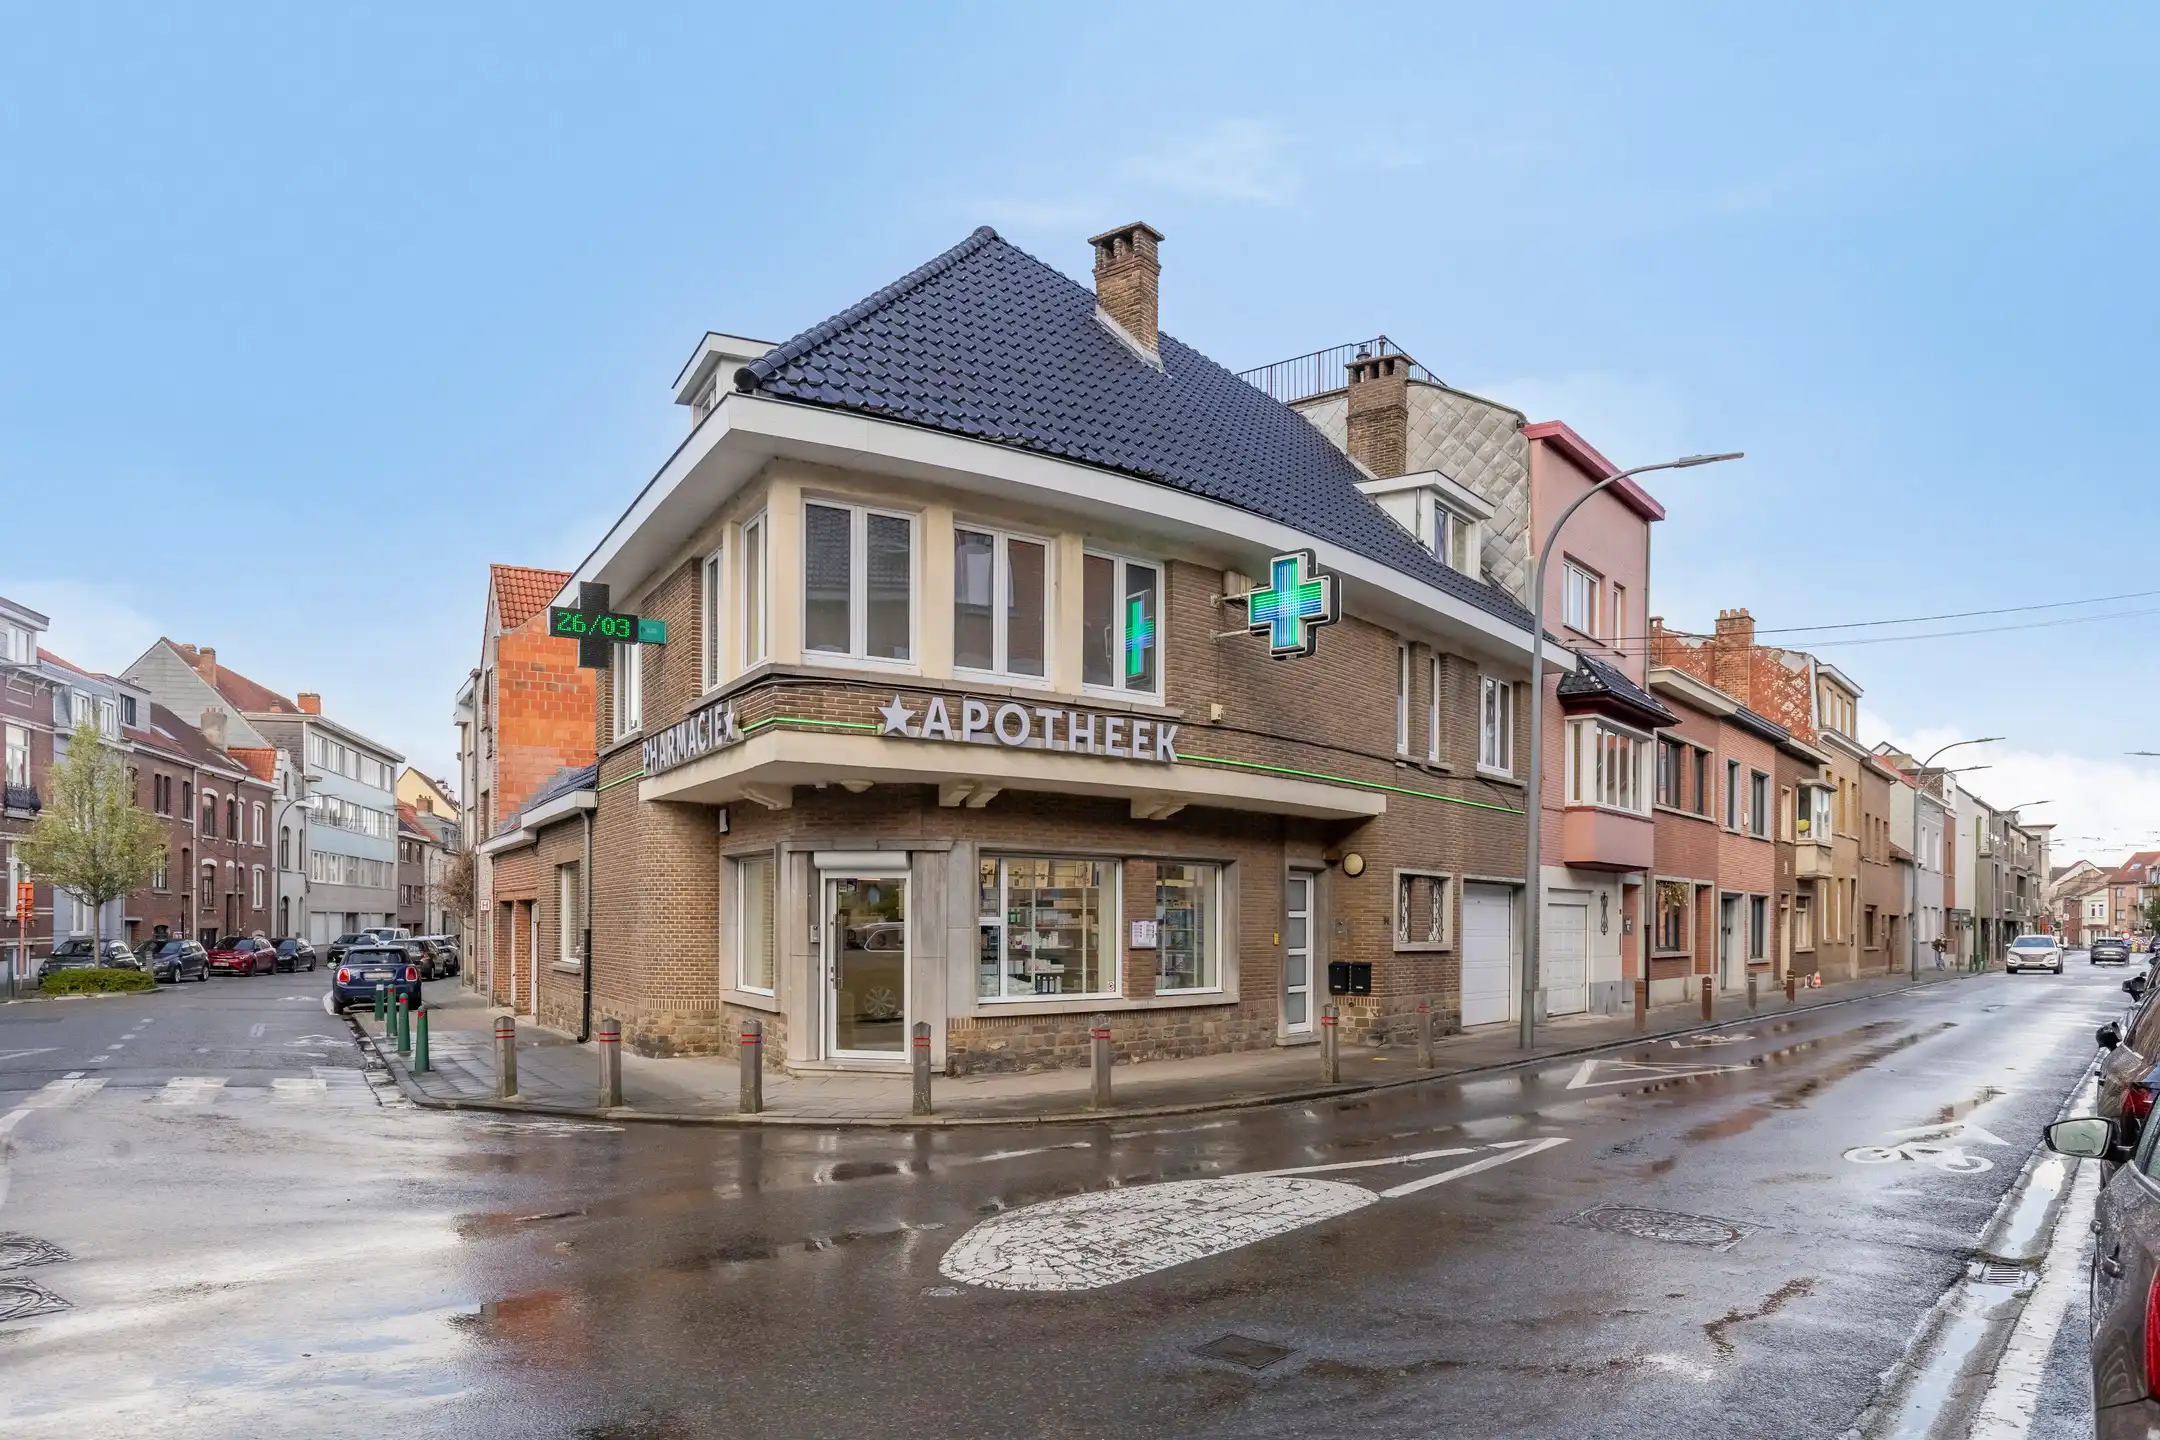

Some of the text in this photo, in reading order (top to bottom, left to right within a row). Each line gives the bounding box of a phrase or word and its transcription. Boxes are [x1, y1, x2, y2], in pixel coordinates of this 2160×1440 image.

[557, 612, 630, 638] 26/03
[643, 703, 723, 776] PHARMACIE
[921, 697, 1179, 763] APOTHEEK
